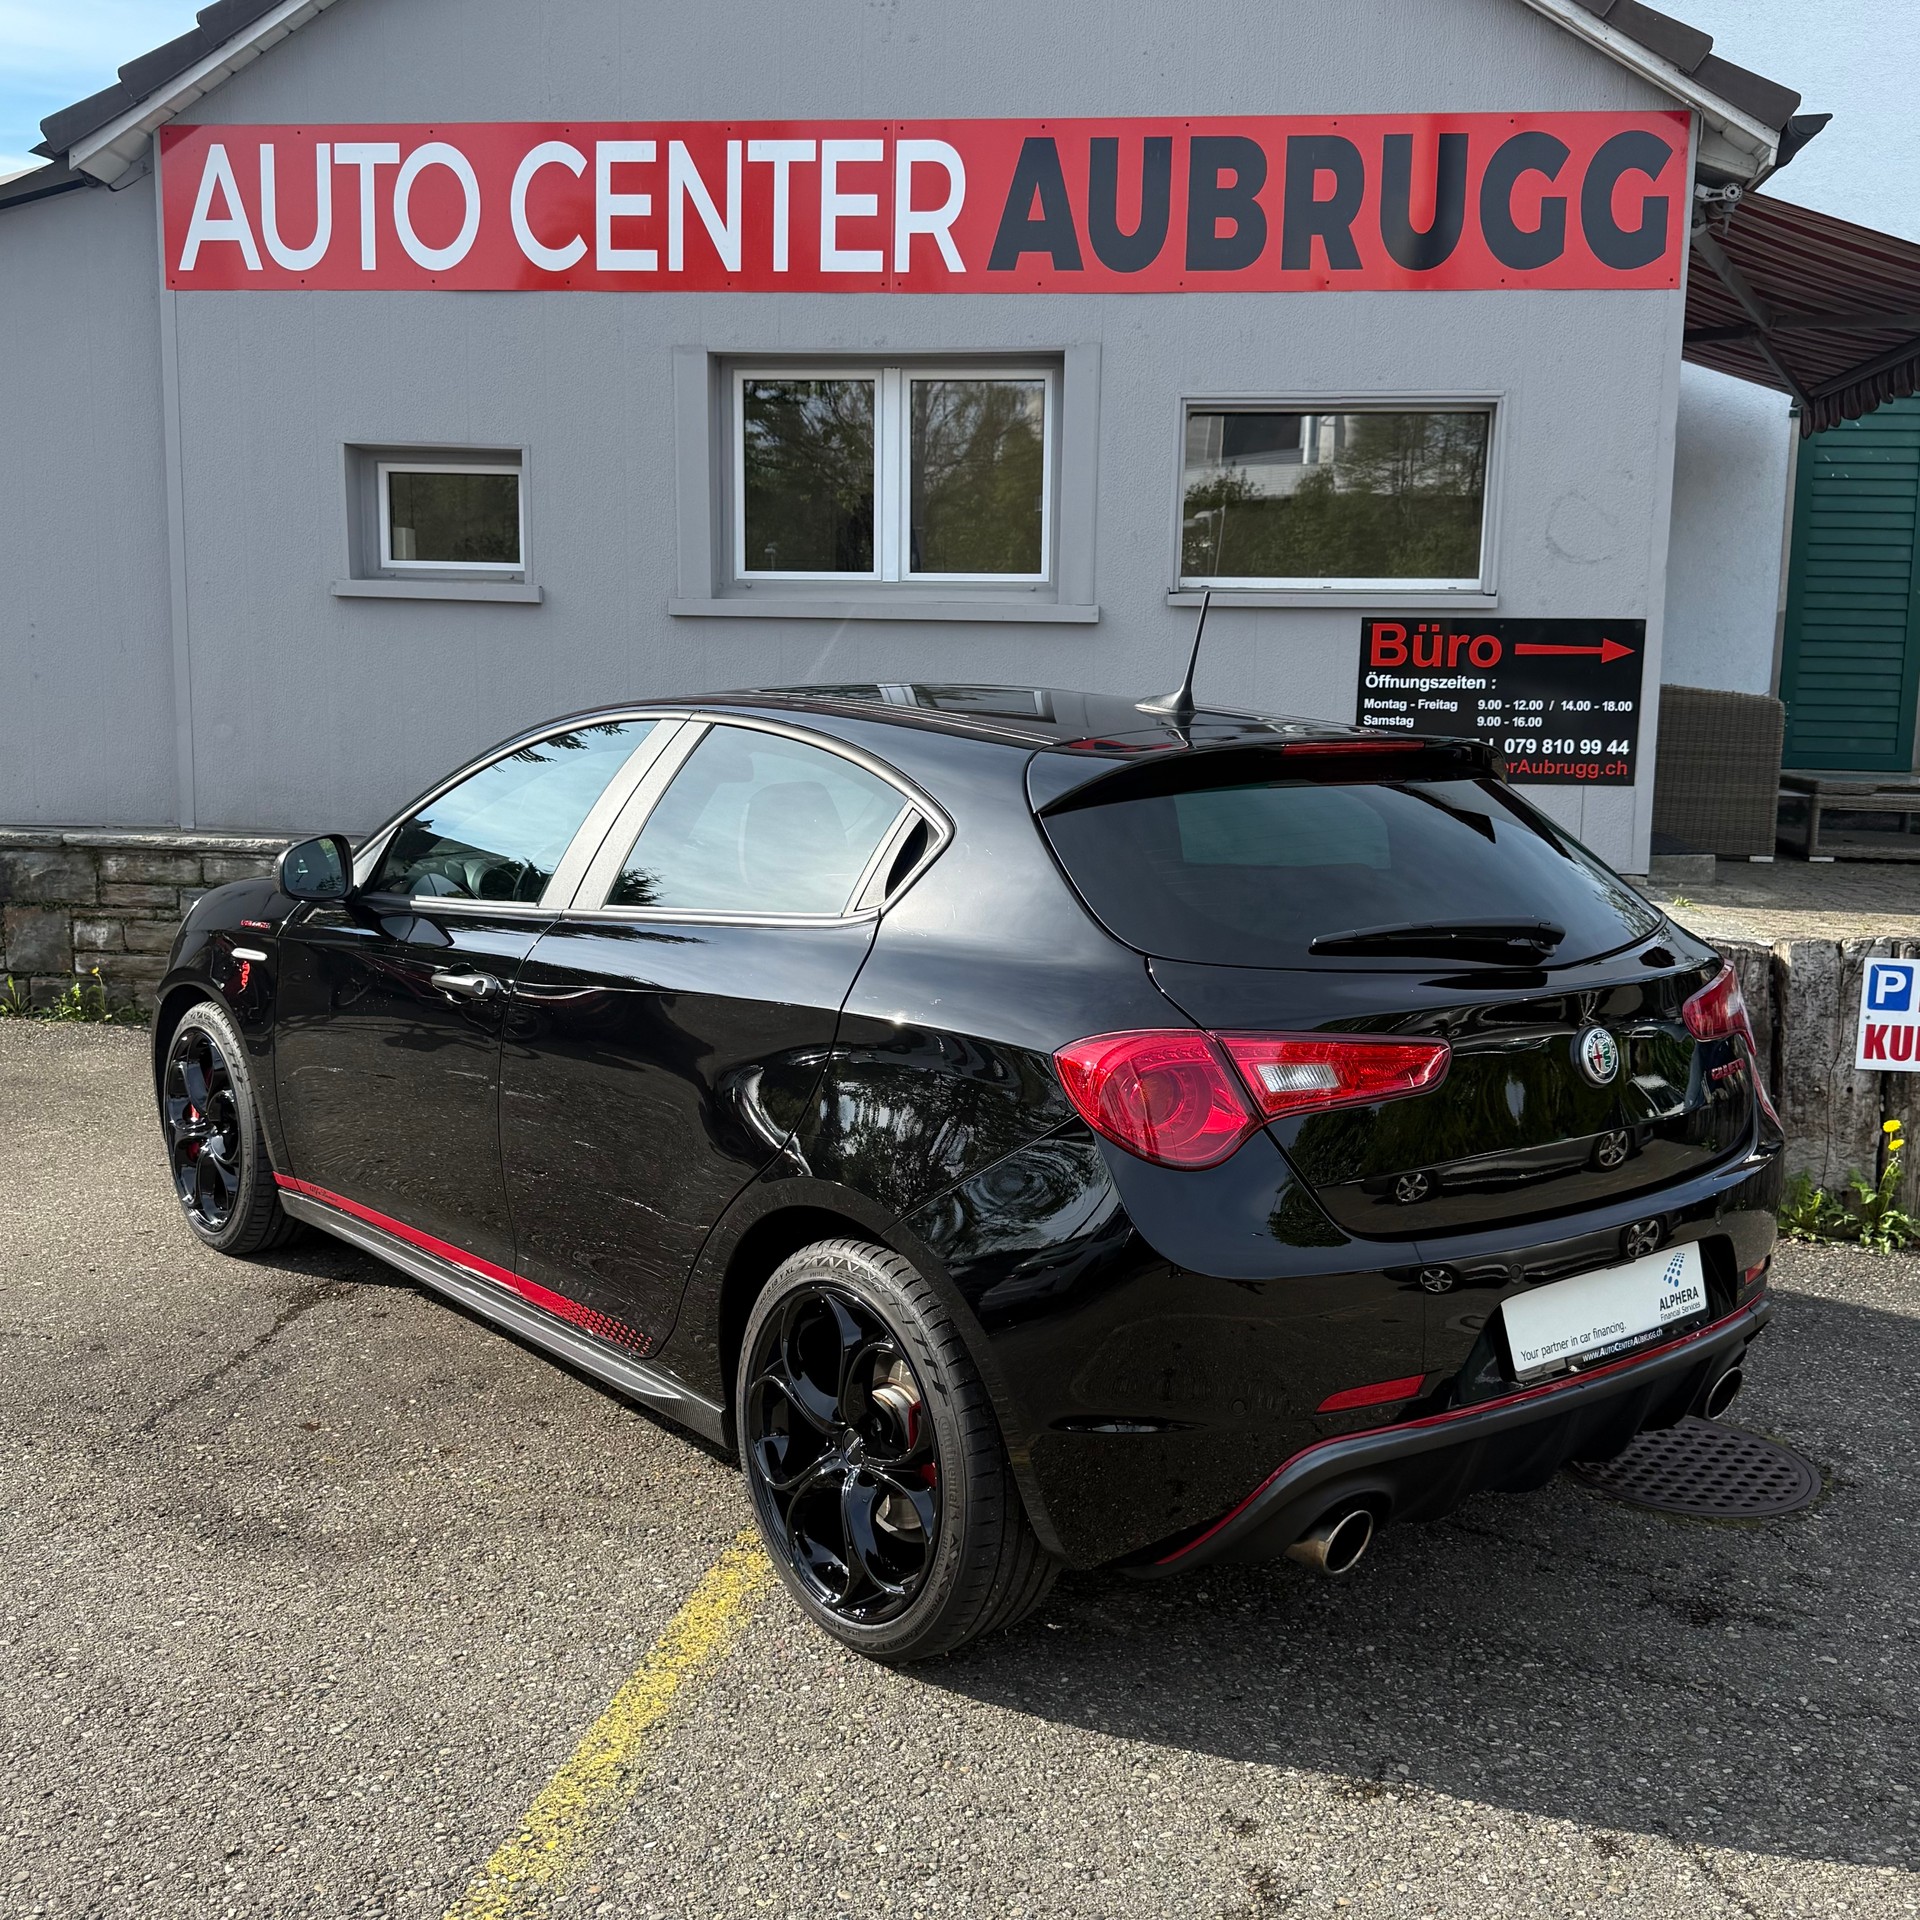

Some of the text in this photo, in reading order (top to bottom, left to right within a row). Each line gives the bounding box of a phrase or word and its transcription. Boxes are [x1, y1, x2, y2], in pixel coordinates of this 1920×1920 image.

[178, 130, 1674, 273] AUTO CENTER AUBRUGG
[1370, 622, 1503, 669] Büro
[1365, 672, 1486, 691] Öffnungszeiten
[1363, 698, 1407, 711] Montag
[1418, 699, 1458, 712] Freitag
[1477, 700, 1502, 711] 9.00
[1513, 700, 1544, 711] 12.00
[1560, 701, 1591, 712] 14.00
[1602, 701, 1633, 712] 18.00
[1363, 715, 1414, 728] Samstag
[1477, 716, 1501, 727] 9.00
[1512, 717, 1542, 728] 16.00
[1504, 738, 1537, 754] 079
[1541, 738, 1575, 755] 810
[1579, 739, 1602, 755] 99
[1606, 740, 1629, 755] 44
[1875, 970, 1907, 1004] P
[1659, 1286, 1699, 1311] ALPHERA
[1660, 1301, 1701, 1322] Financial Services
[1521, 1320, 1627, 1362] Your partner in car financing.
